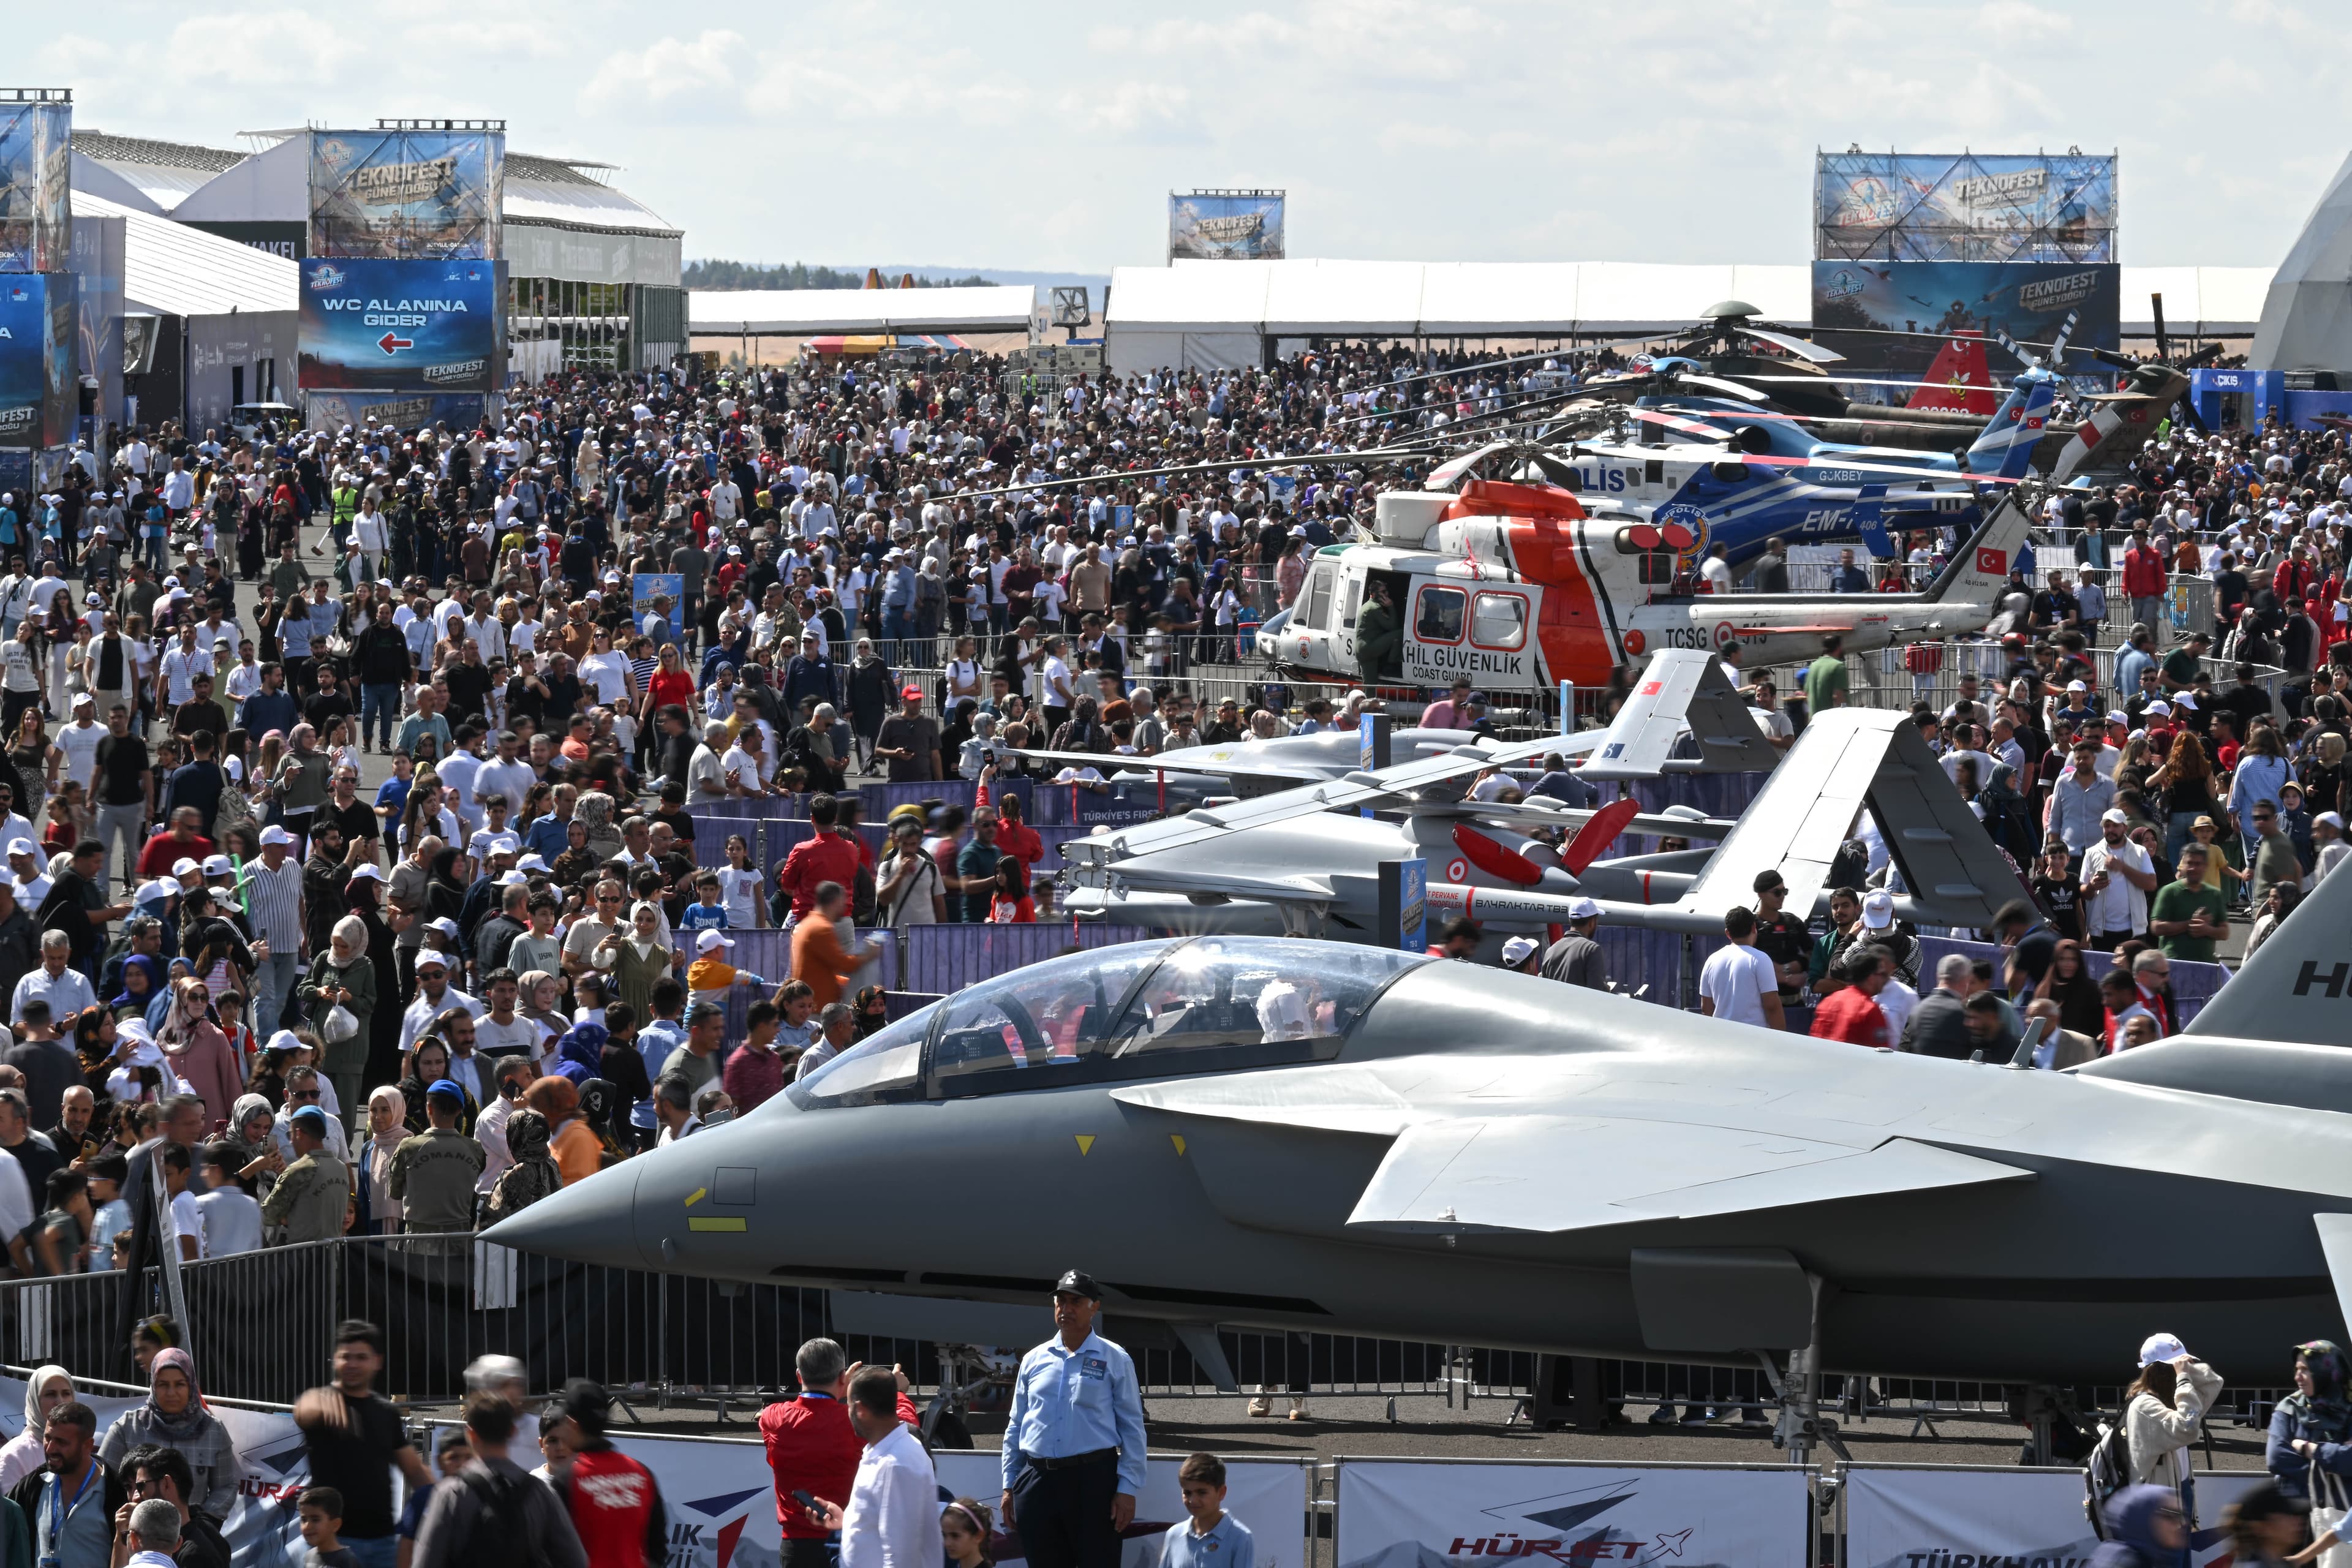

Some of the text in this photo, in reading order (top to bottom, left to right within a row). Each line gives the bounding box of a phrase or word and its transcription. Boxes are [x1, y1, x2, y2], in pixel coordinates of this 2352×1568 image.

[347, 156, 454, 190] TEKNOFEST
[366, 180, 438, 200] GÜNEYDOĞU
[1956, 172, 2045, 198] TEKNOFEST
[1839, 201, 1902, 227] TEKNOFEST
[311, 276, 345, 288] TEKNOFEST
[2019, 270, 2099, 300] TEKNOFEST
[1826, 283, 1864, 300] TEKNOFEST
[323, 299, 468, 312] WC ALANINA
[424, 361, 484, 377] TEKNOFEST
[360, 398, 433, 420] TEKNOFEST
[1669, 507, 1703, 518] POLİS
[1860, 521, 1878, 530] 406
[635, 594, 679, 609] TEKNST
[1665, 627, 1708, 649] TCSG
[1434, 646, 1522, 675] GÜVENLİK
[1412, 666, 1441, 681] COAST
[1082, 809, 1131, 821] TÜRKİYE'S
[1428, 899, 1463, 910] PROPELLER
[1431, 891, 1459, 900] PERVANE
[1475, 899, 1545, 913] BAYRAKTAR
[694, 917, 720, 929] SONIC
[2292, 960, 2352, 999] H
[411, 1151, 481, 1170] KOMANDO
[312, 1177, 350, 1197] KOMAN
[1447, 1532, 1648, 1559] HÜRJET
[1905, 1548, 2092, 1568] TÜRKHAV
